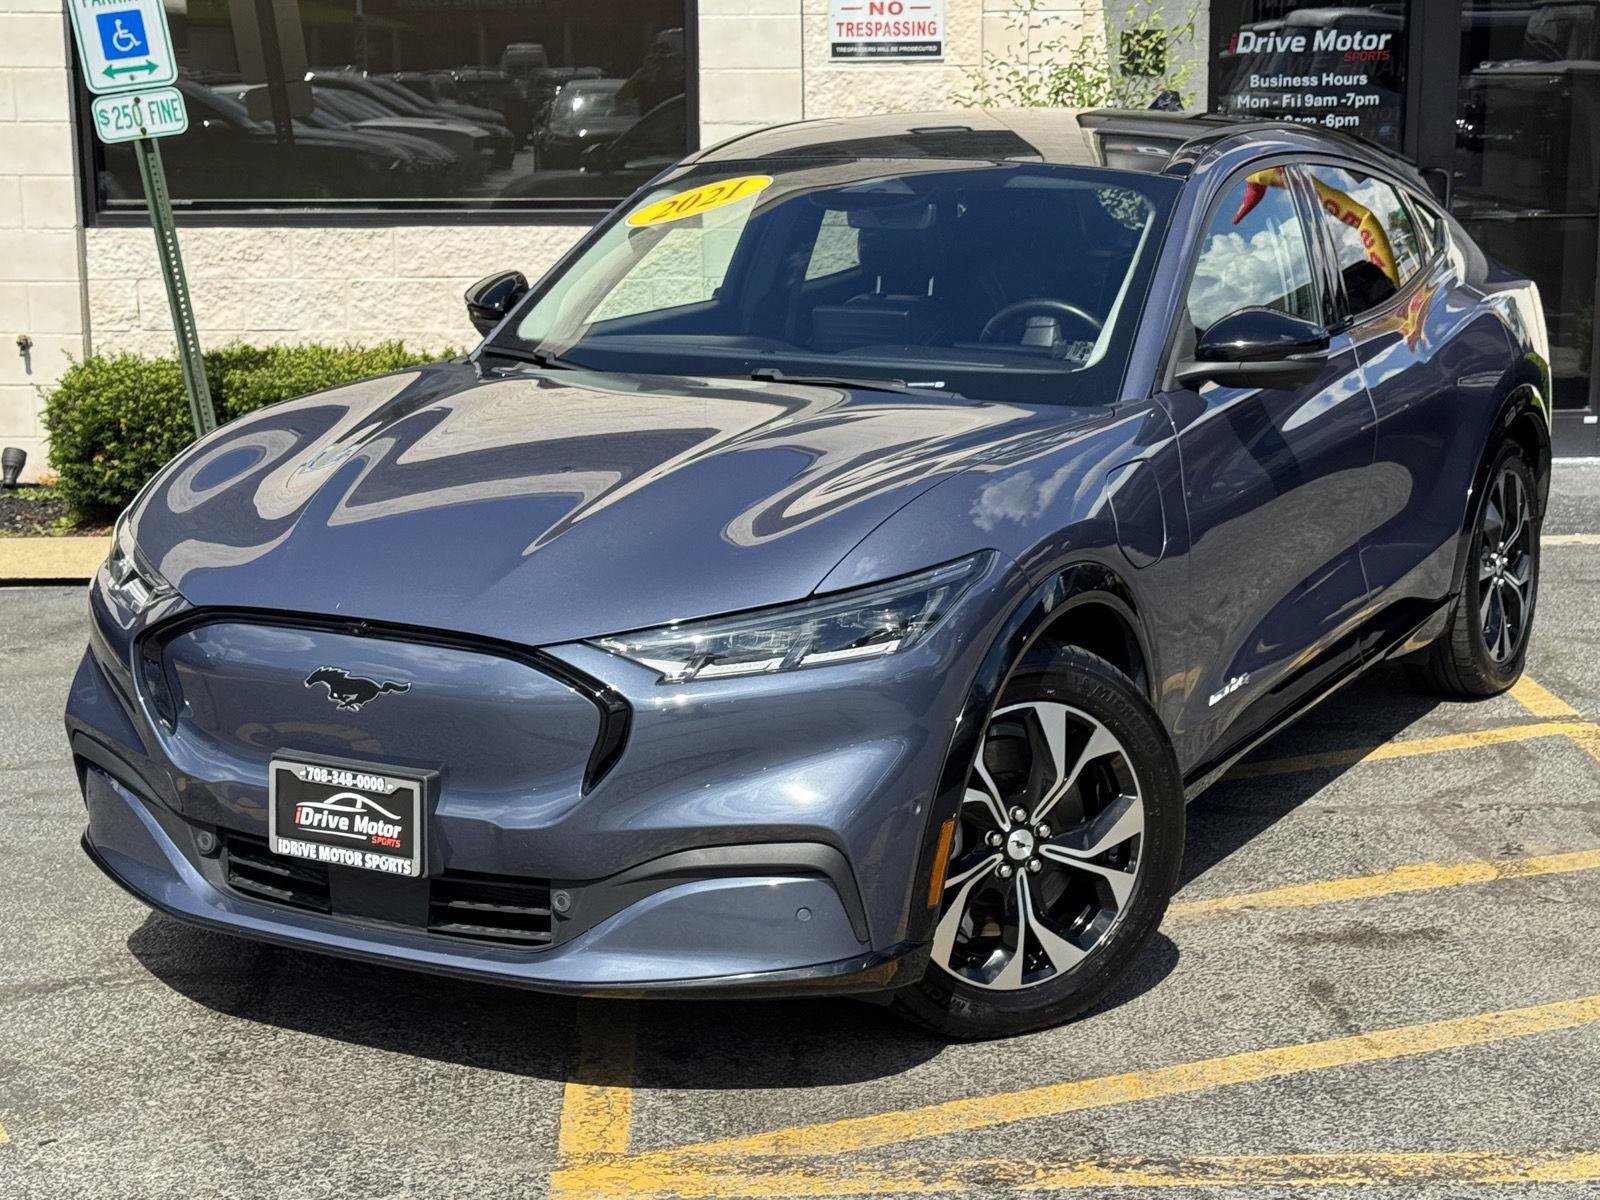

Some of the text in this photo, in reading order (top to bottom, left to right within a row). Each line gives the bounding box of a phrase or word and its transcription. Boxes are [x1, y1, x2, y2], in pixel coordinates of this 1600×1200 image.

[869, 1, 903, 15] NO
[836, 21, 937, 37] TRESPASSING
[1228, 29, 1392, 54] iDrive Motor
[1343, 50, 1391, 62] SPORTS
[1250, 73, 1368, 88] Business Hours
[148, 98, 182, 125] FINE
[1237, 95, 1269, 109] Mon
[1304, 94, 1338, 107] 9am
[649, 180, 749, 222] 2021
[306, 767, 384, 792] 708-348-0000
[295, 806, 402, 839] iDrive Motor
[371, 835, 401, 849] SPORTS
[318, 846, 362, 868] MOTOR
[365, 853, 412, 875] SPORTS
